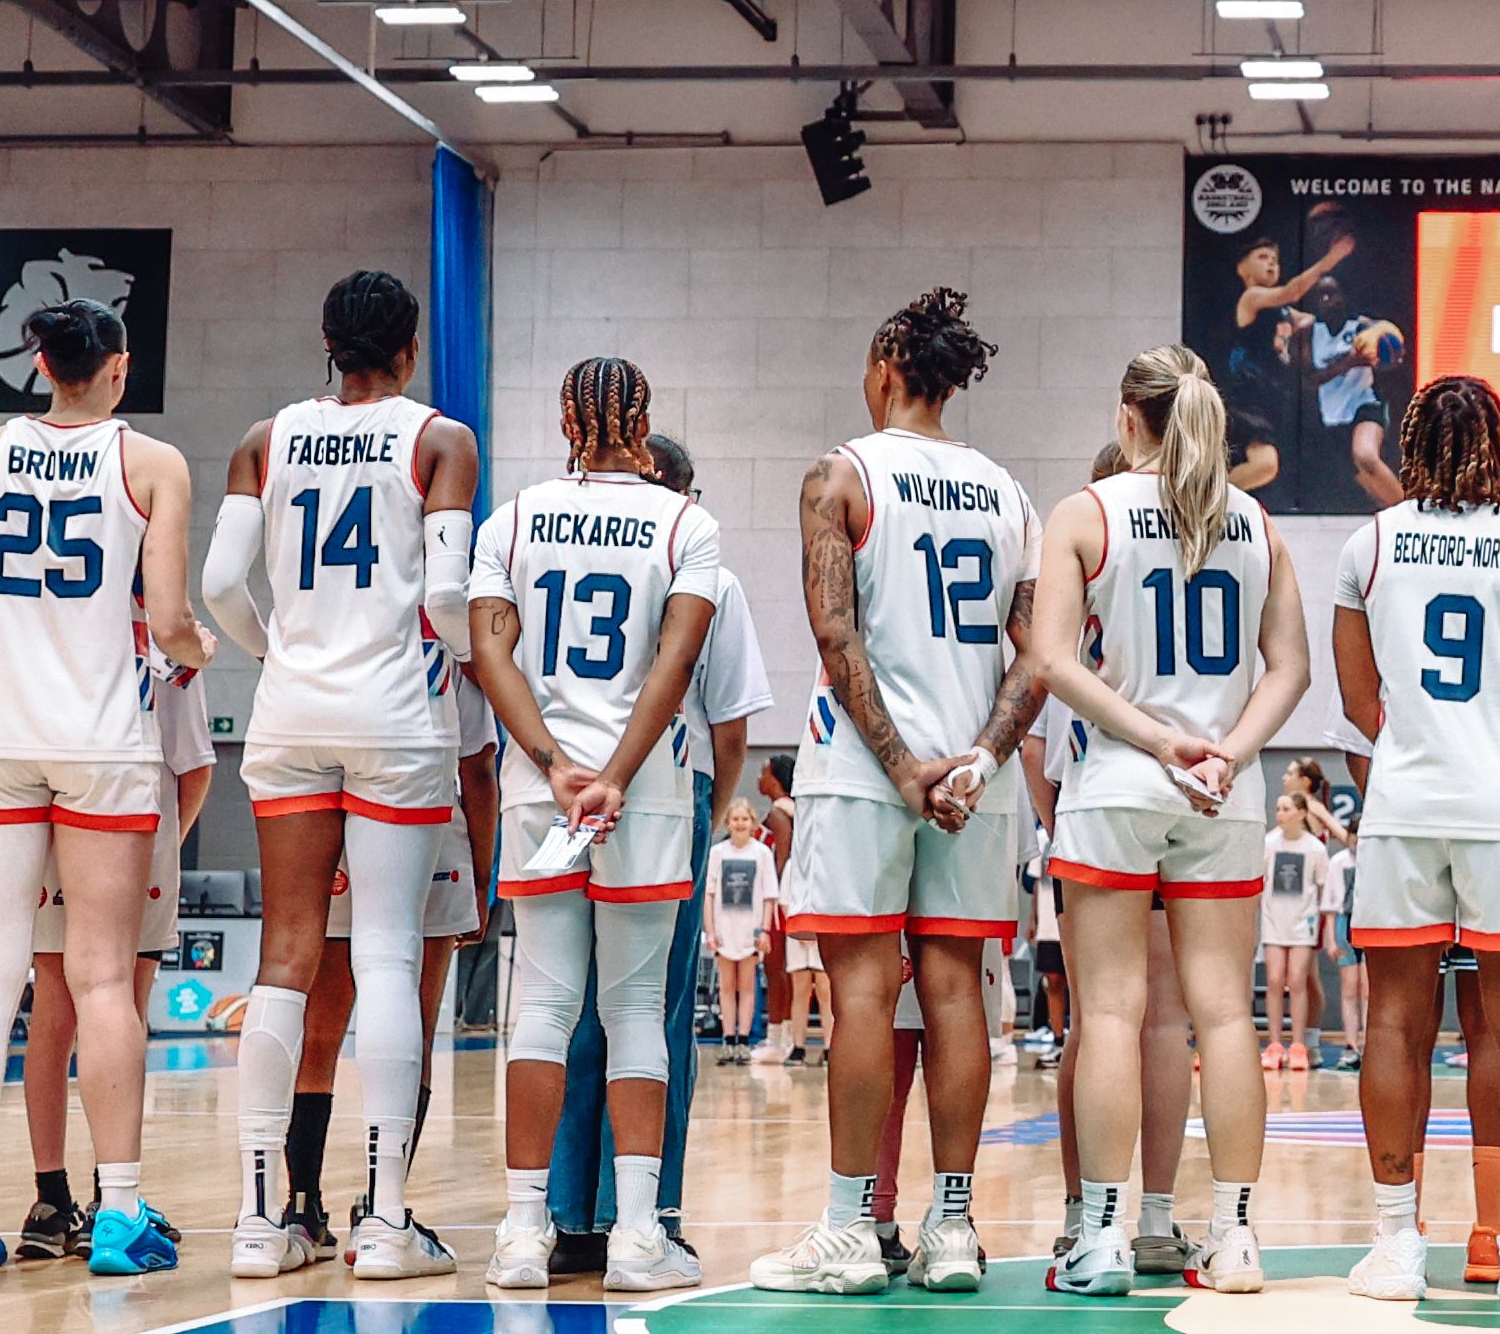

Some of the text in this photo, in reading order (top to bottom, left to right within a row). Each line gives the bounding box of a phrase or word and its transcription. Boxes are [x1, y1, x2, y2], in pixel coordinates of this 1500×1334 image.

[1290, 177, 1391, 195] WELCOME
[1401, 177, 1425, 195] TO
[1433, 177, 1472, 195] THE
[8, 445, 98, 482] BROWN
[287, 433, 398, 466] FAGBENLE
[891, 473, 1001, 517] WILKINSON
[290, 485, 380, 591] 14
[530, 512, 657, 550] RICKARDS
[913, 532, 999, 645] 12
[533, 569, 632, 681] 13
[1141, 567, 1240, 677] 10
[1420, 592, 1486, 703] 9
[1332, 793, 1355, 827] 2
